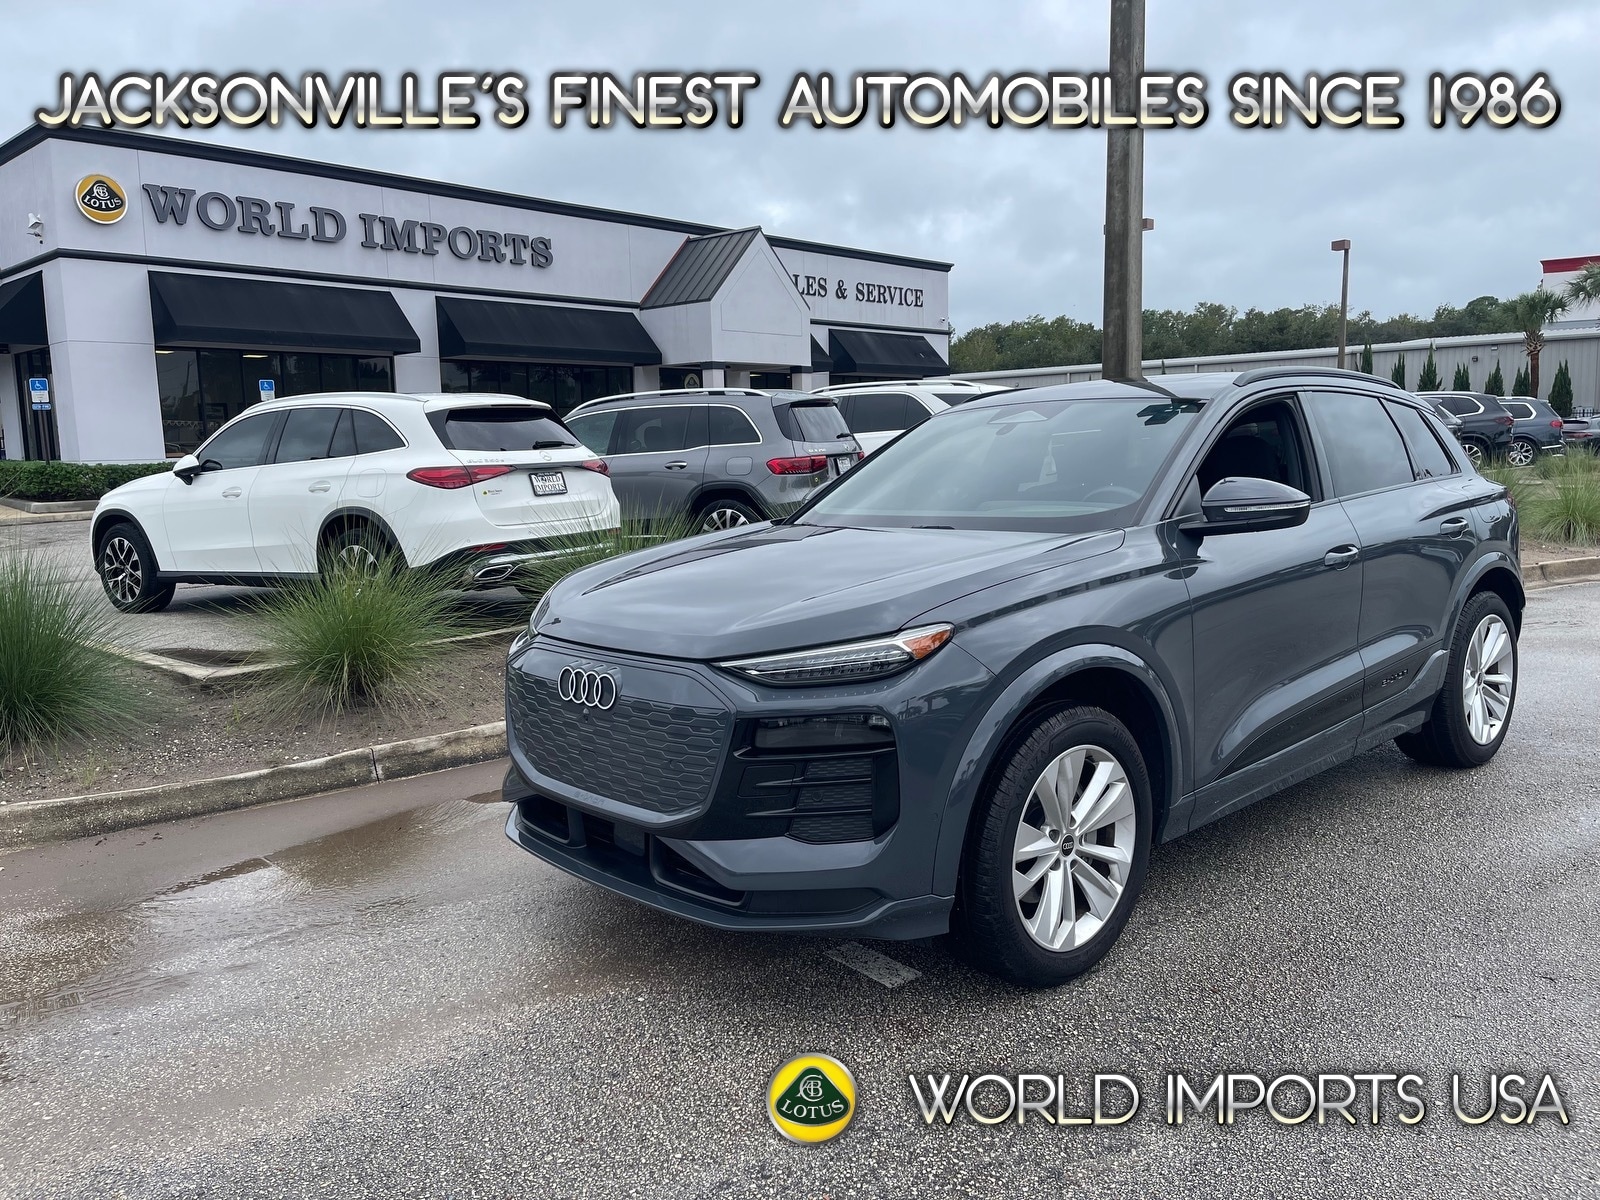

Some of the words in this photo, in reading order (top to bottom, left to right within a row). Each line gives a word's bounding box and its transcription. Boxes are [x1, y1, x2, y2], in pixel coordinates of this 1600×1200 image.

[83, 194, 122, 209] LOTUS
[142, 183, 347, 243] WORLD
[359, 213, 553, 268] IMPORTS
[835, 279, 848, 300] &
[855, 281, 924, 308] SERVICE
